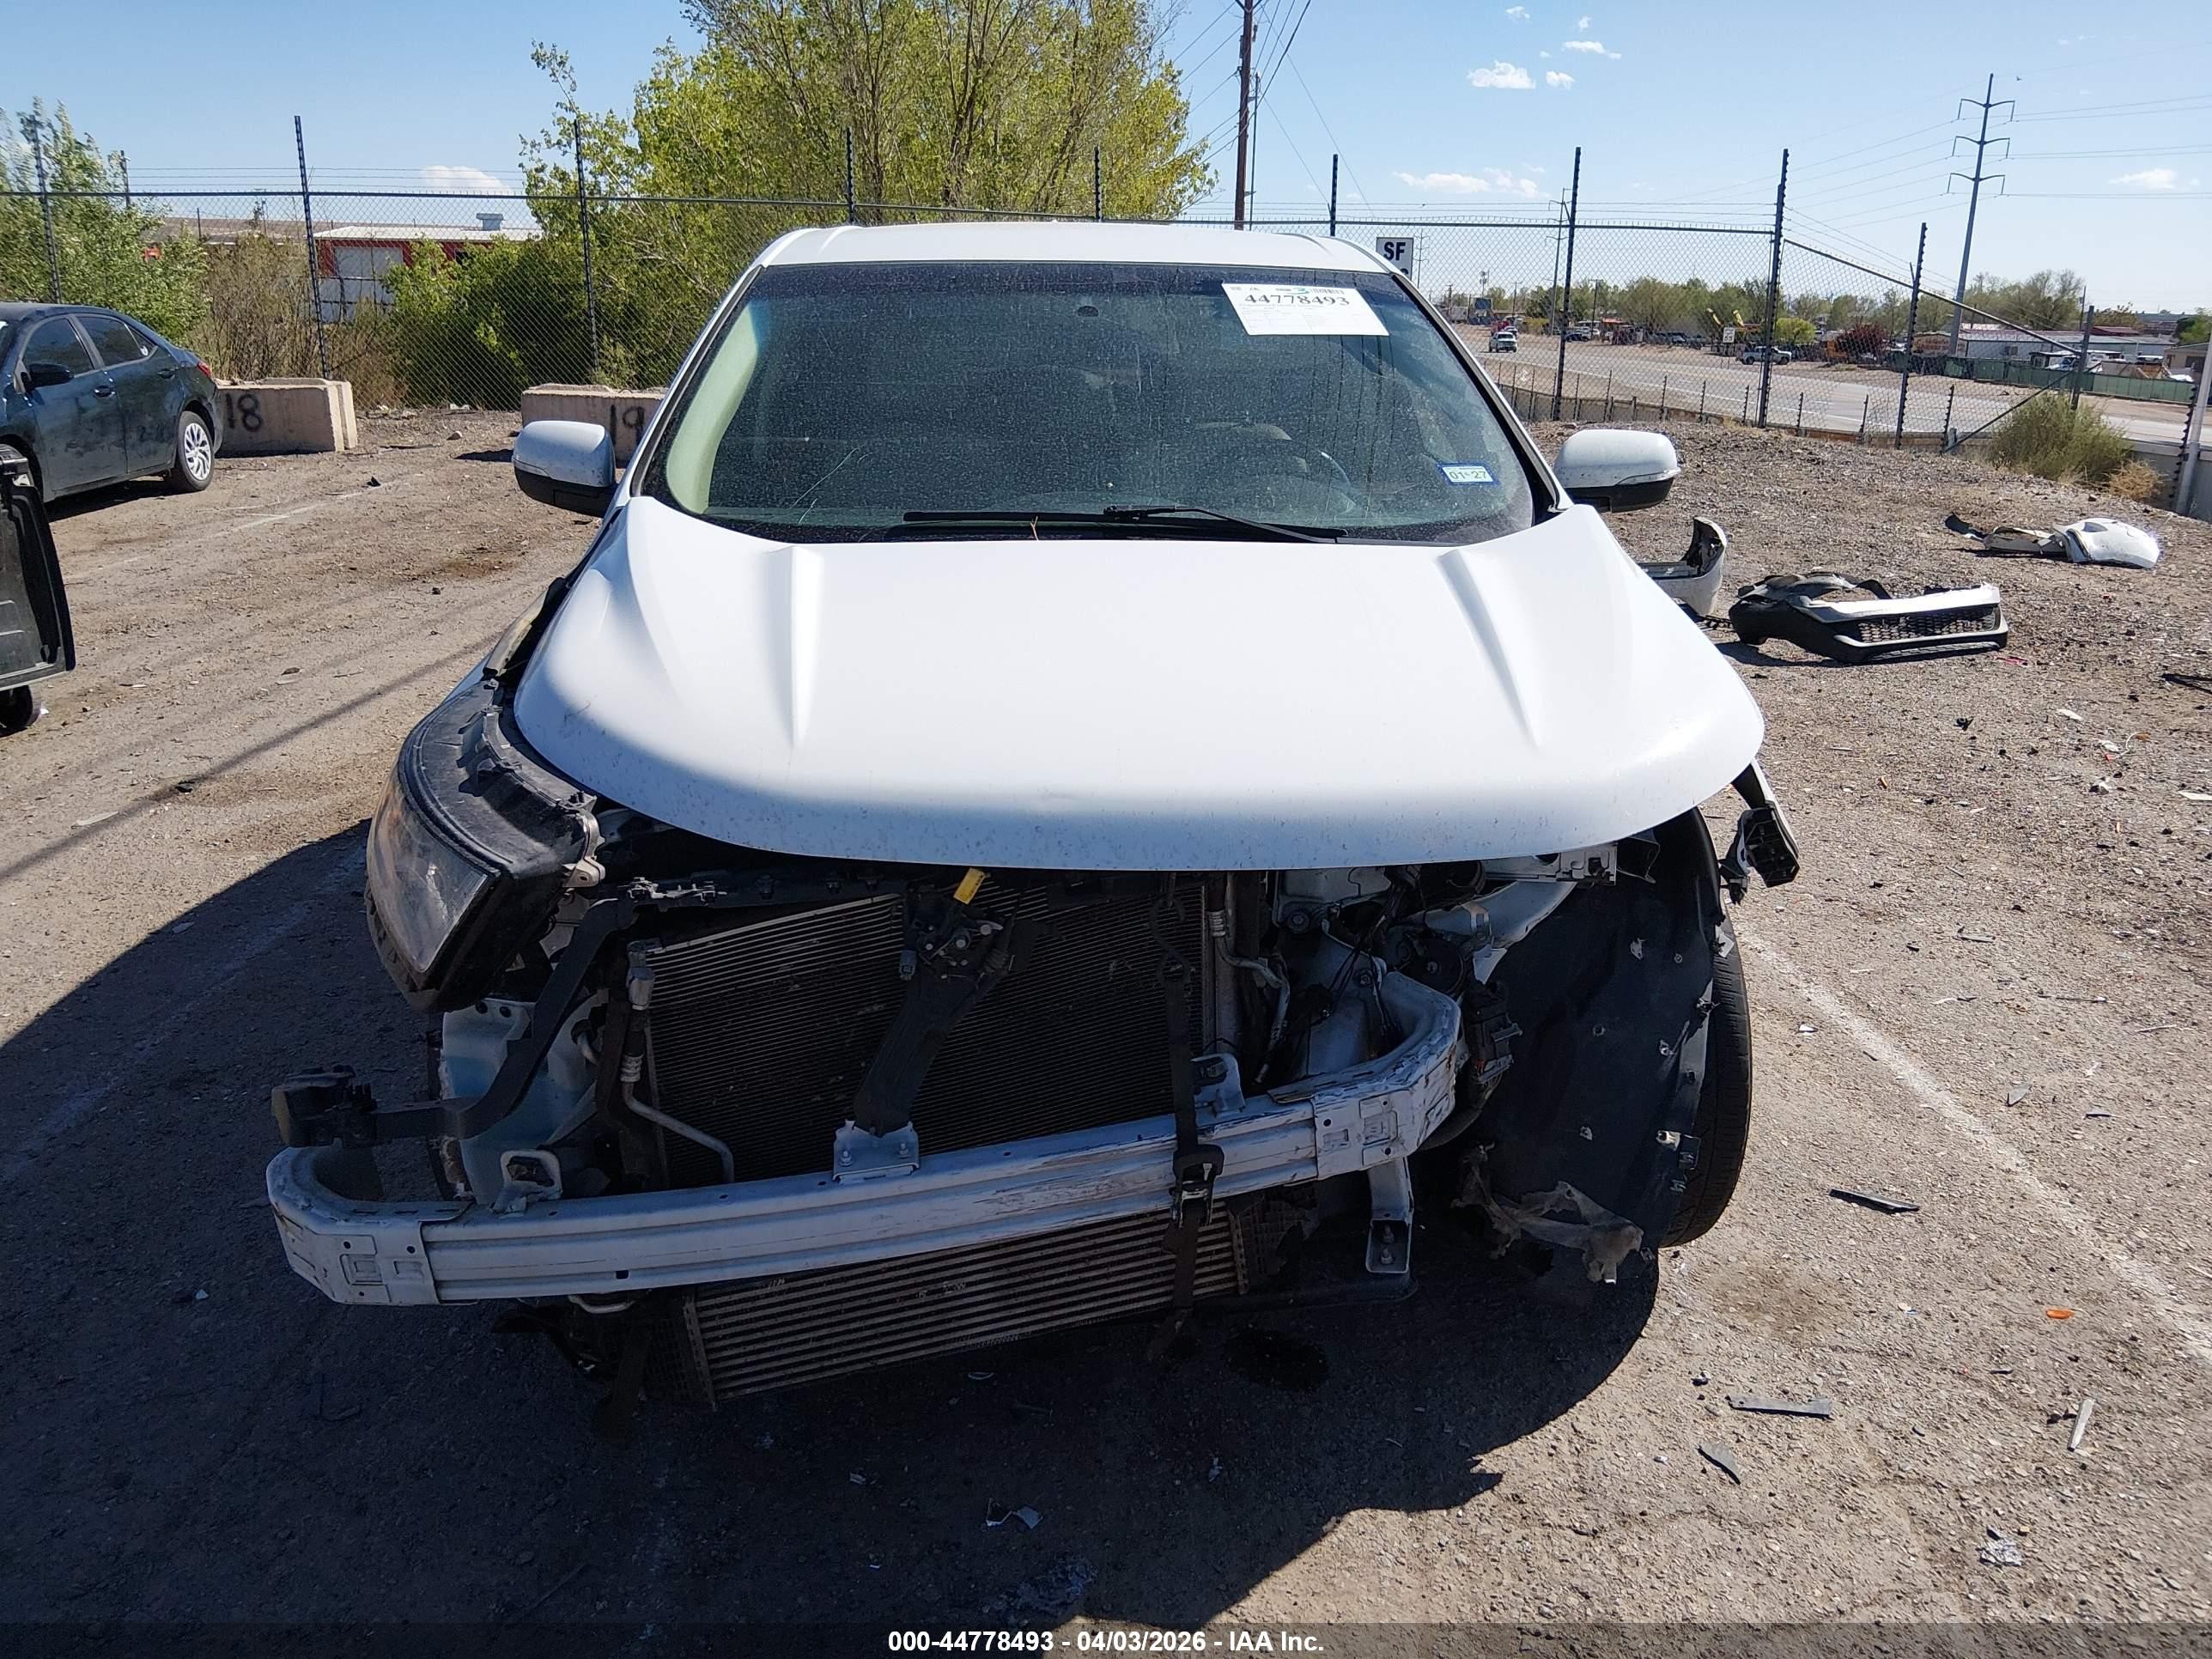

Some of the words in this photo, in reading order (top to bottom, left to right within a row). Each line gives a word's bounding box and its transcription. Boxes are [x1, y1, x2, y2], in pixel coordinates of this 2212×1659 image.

[1383, 241, 1406, 261] SF
[1245, 294, 1350, 306] 44778493
[225, 393, 264, 432] 18
[610, 404, 645, 446] 19
